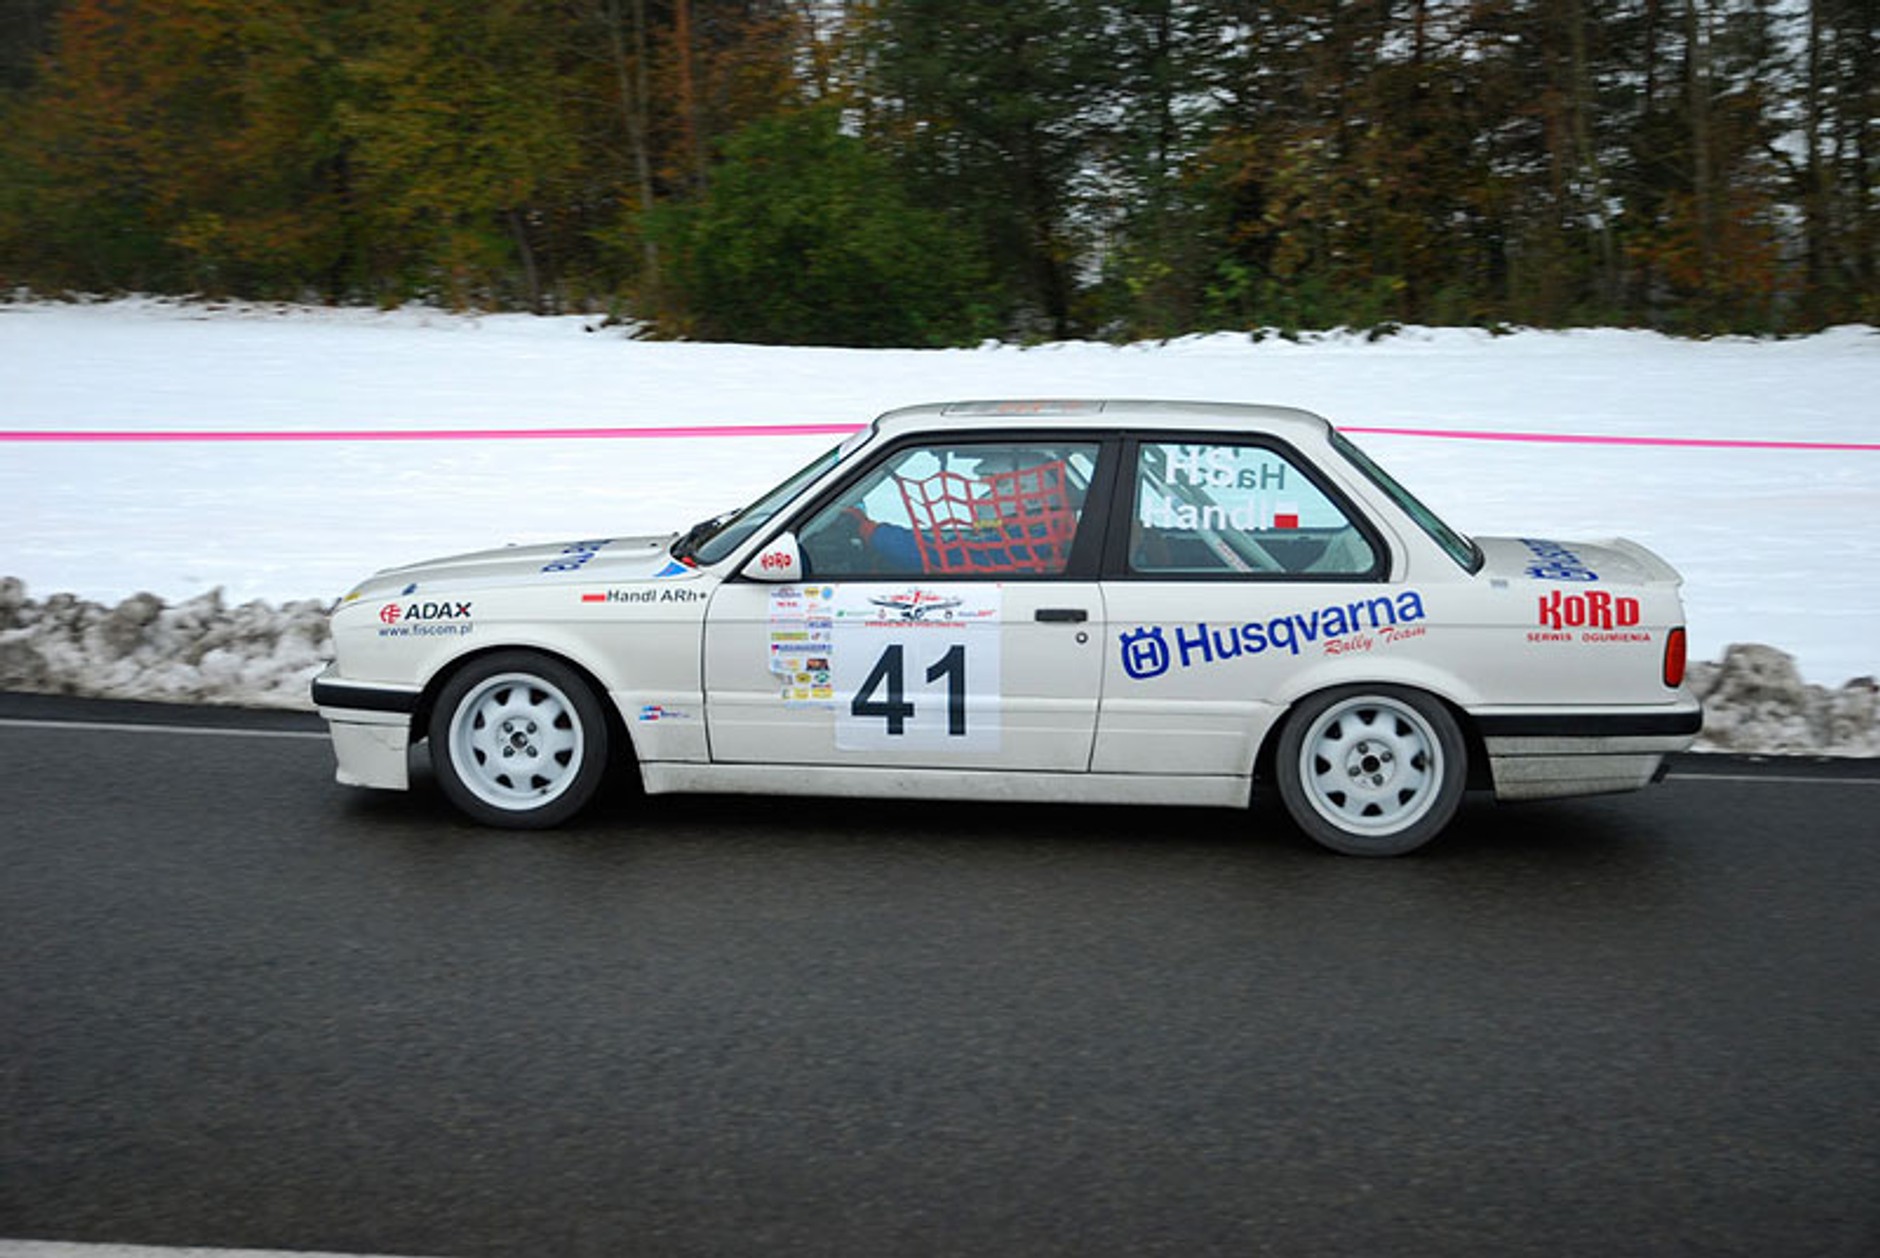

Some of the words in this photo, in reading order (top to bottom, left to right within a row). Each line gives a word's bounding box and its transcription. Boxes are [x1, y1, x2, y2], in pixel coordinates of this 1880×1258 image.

[1143, 495, 1268, 531] Handl
[606, 590, 657, 602] Handl
[1538, 588, 1641, 630] KORD
[404, 602, 472, 620] ADAX
[378, 622, 474, 637] www.fiscom.pl
[1175, 589, 1428, 669] Husqvarna
[1323, 632, 1373, 655] Rally
[1378, 626, 1426, 644] Team
[1526, 631, 1573, 643] SERWIS
[1581, 631, 1652, 643] OGUMIENIA
[851, 644, 966, 736] 41
